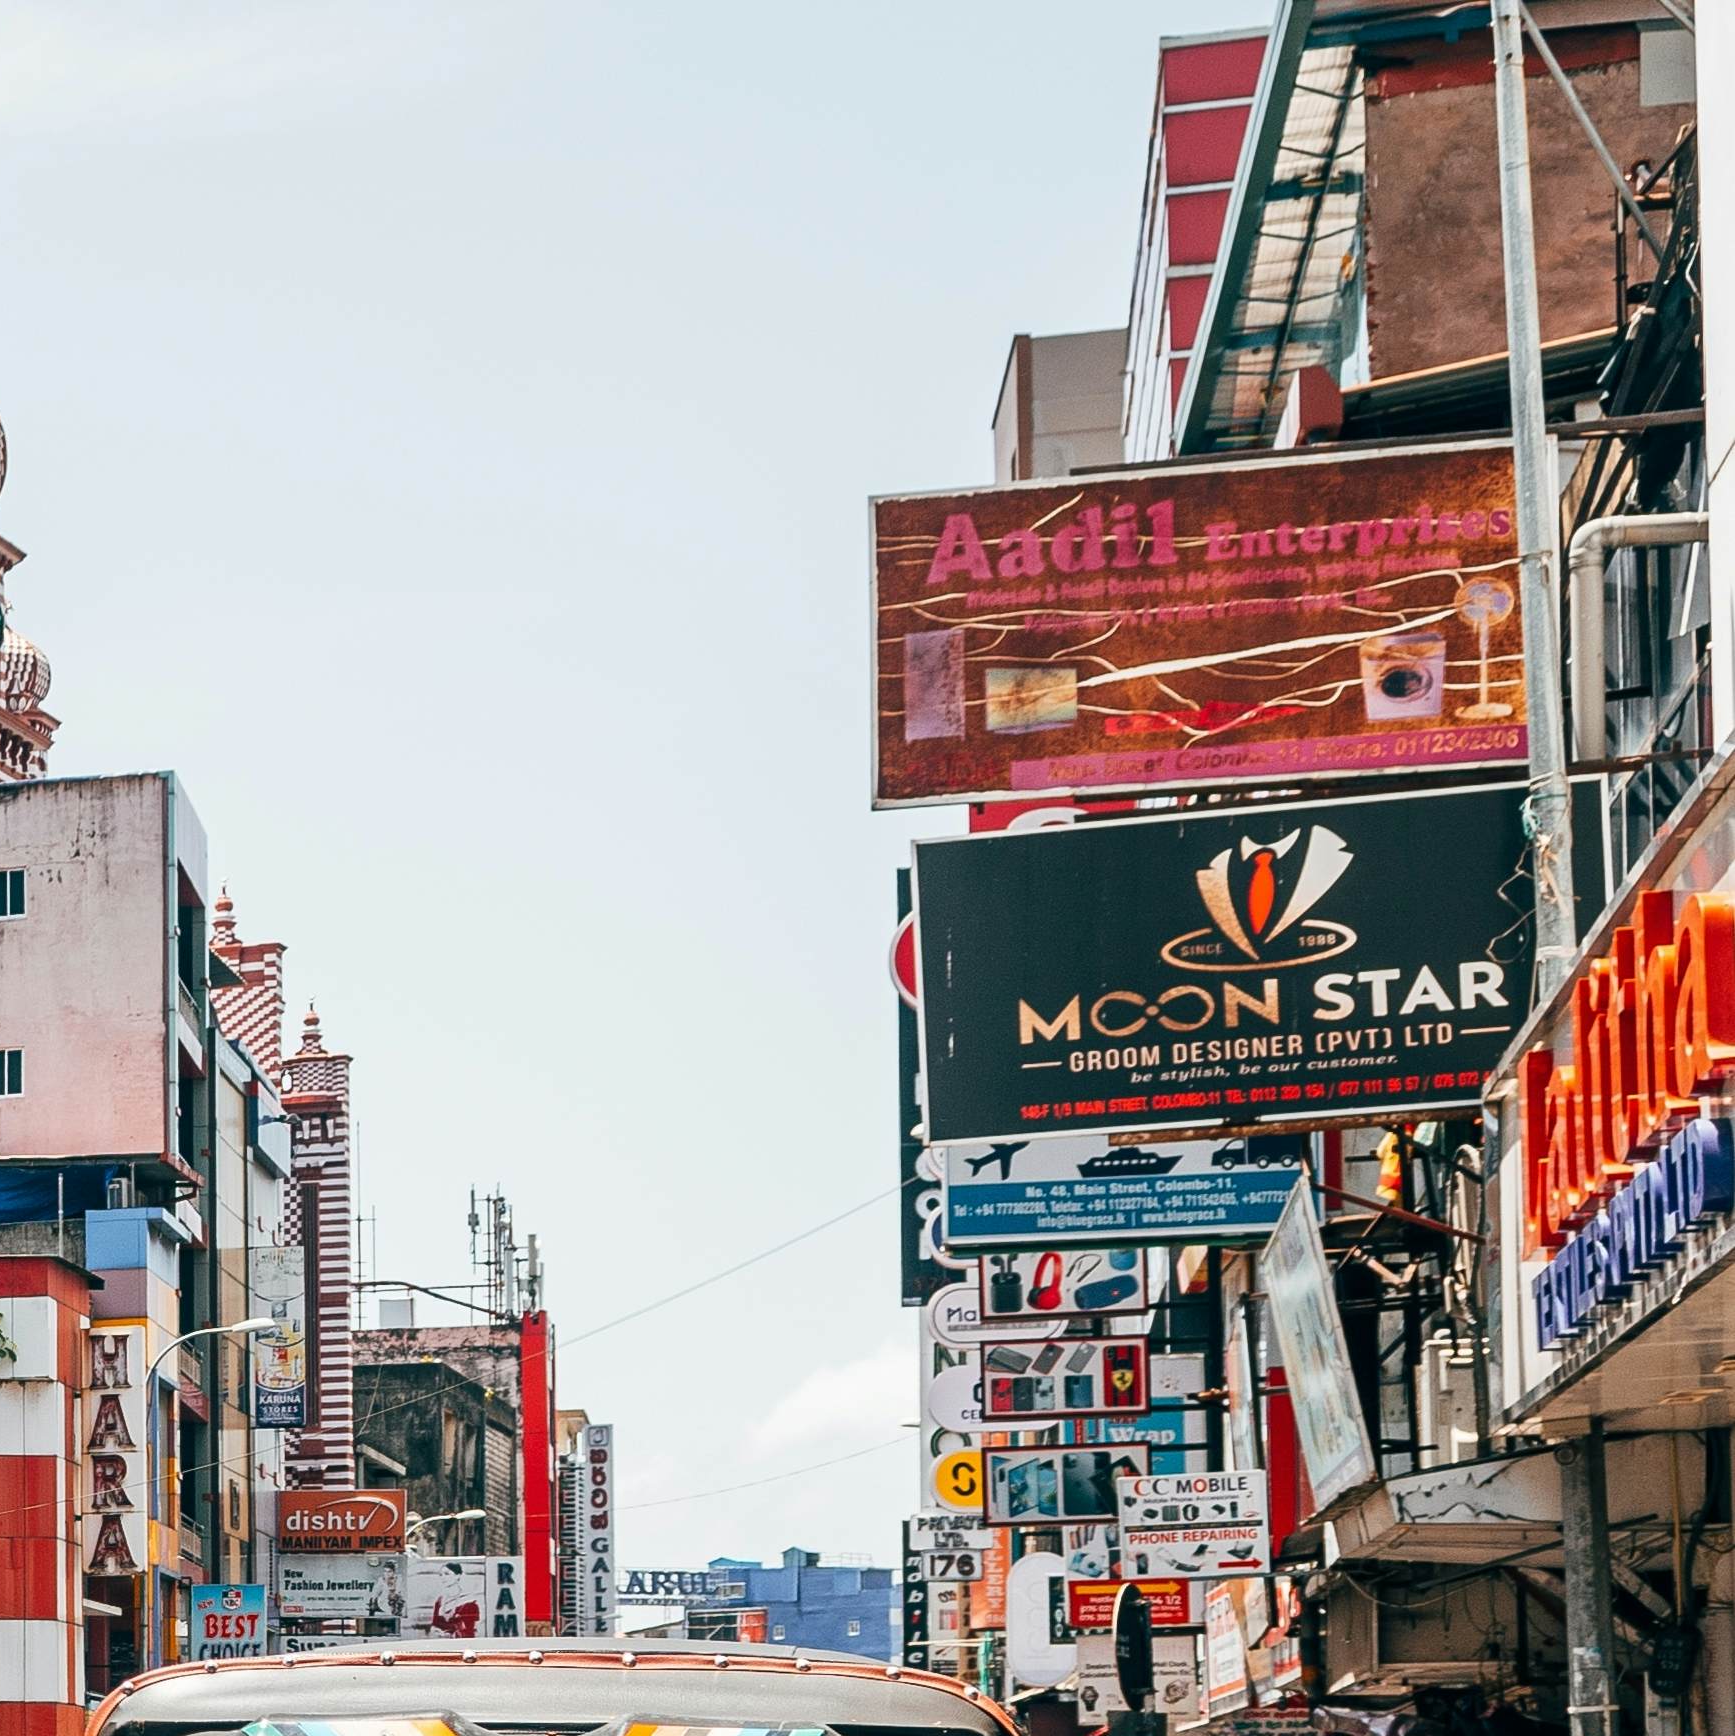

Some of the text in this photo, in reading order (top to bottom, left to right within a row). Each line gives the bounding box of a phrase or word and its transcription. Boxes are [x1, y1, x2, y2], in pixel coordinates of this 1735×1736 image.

[927, 500, 1513, 585] Aadil Enterprises
[1181, 932, 1337, 958] SINCE 1988
[1017, 960, 1510, 1045] MOON STAR
[1068, 1021, 1454, 1073] GROOM DESIGNER LTD
[1129, 1053, 1399, 1084] be stylish, be our customer.
[1075, 1099, 1105, 1117] MAIN
[1074, 1183, 1106, 1197] Main
[1108, 1181, 1152, 1198] Street,
[257, 1392, 302, 1406] KARUNA
[262, 1405, 299, 1415] STORES
[1108, 1427, 1177, 1445] Wrap
[87, 1334, 138, 1569] HARA
[1133, 1476, 1248, 1497] CC MOBILE
[285, 1500, 384, 1534] dishtv
[917, 1515, 985, 1532] PRIVATE
[359, 1535, 403, 1550] IMPEX
[933, 1532, 970, 1549] LTD.
[1129, 1528, 1258, 1545] PHONE REPAIRING
[284, 1568, 305, 1580] New
[929, 1554, 975, 1577] 176
[284, 1579, 376, 1594] Fashion Jewellery
[204, 1614, 260, 1640] BEST
[200, 1642, 262, 1662] CHOICE
